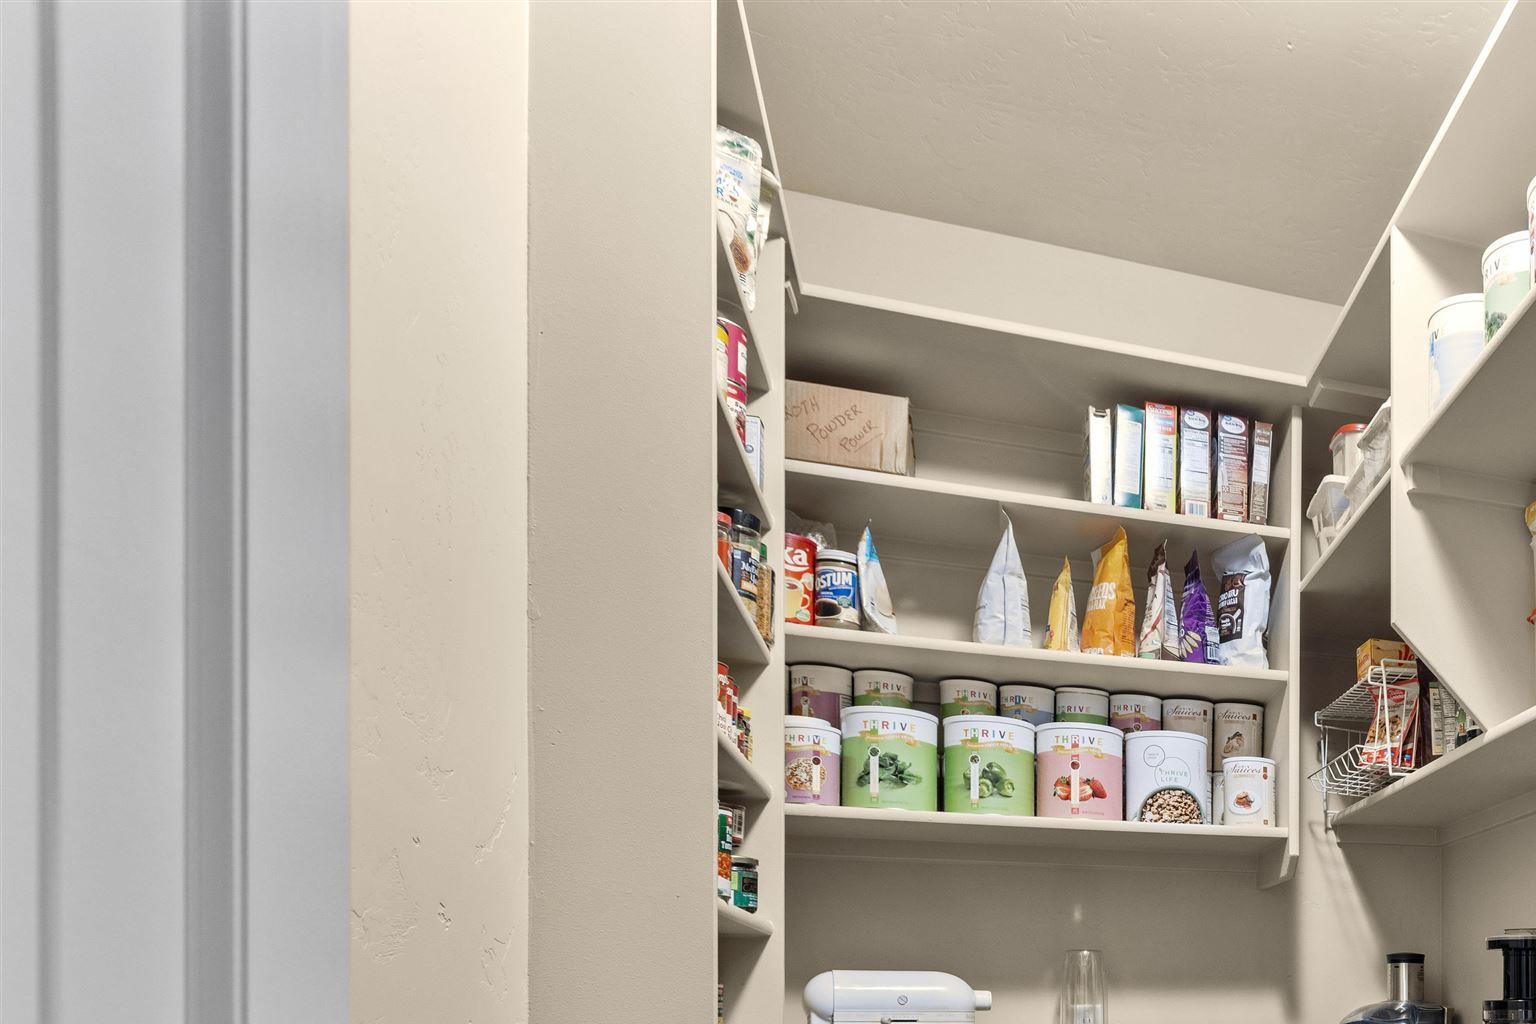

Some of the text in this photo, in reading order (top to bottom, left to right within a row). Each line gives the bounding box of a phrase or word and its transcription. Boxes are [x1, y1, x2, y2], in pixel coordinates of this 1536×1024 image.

[806, 404, 863, 445] POWDER
[839, 419, 880, 453] POWER
[863, 719, 917, 733] THRIVE
[963, 728, 1015, 741] THRIVE
[1054, 734, 1105, 746] THRIVE
